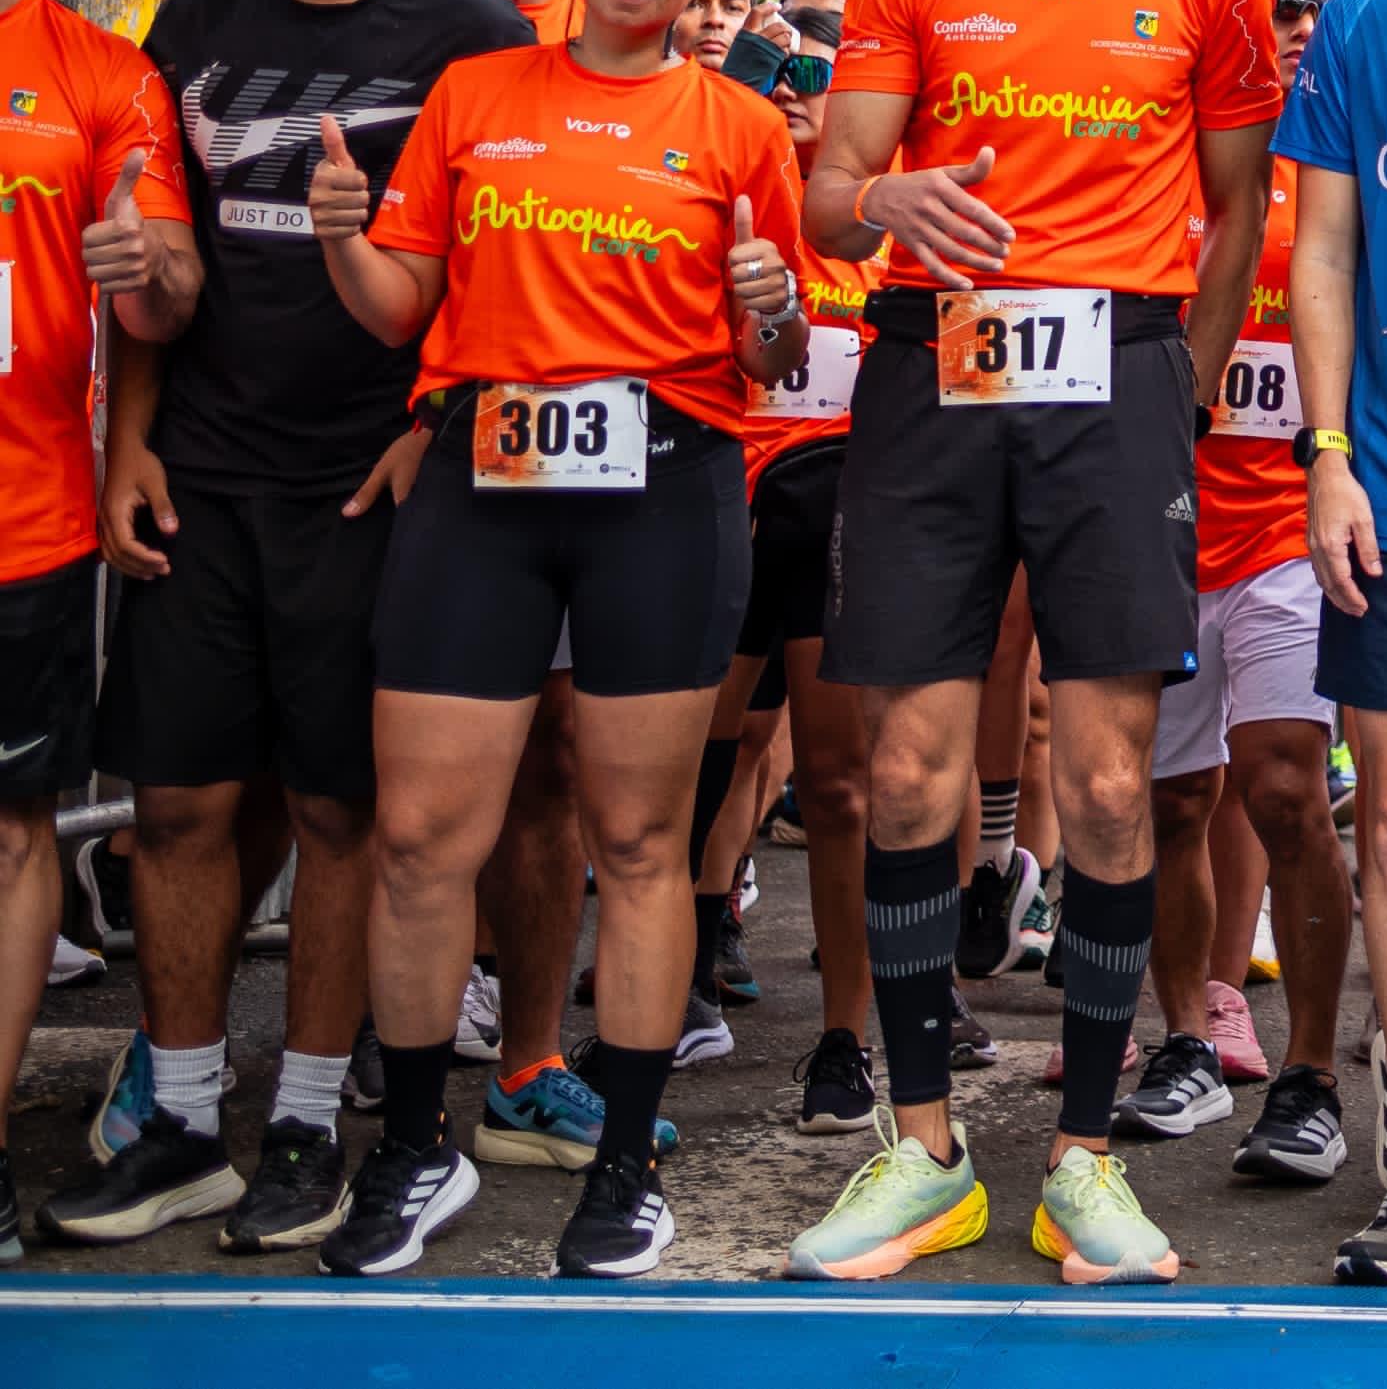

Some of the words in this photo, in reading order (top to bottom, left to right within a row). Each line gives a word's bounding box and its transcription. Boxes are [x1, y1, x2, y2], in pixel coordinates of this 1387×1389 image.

[934, 16, 1017, 35] Comfenalco
[933, 72, 1170, 138] Antioquia
[1073, 121, 1140, 140] corre
[227, 207, 268, 224] JUST
[275, 211, 304, 227] DO
[457, 185, 701, 252] Antioquia
[591, 238, 660, 263] corre
[976, 315, 1065, 373] 317
[500, 399, 608, 456] 303
